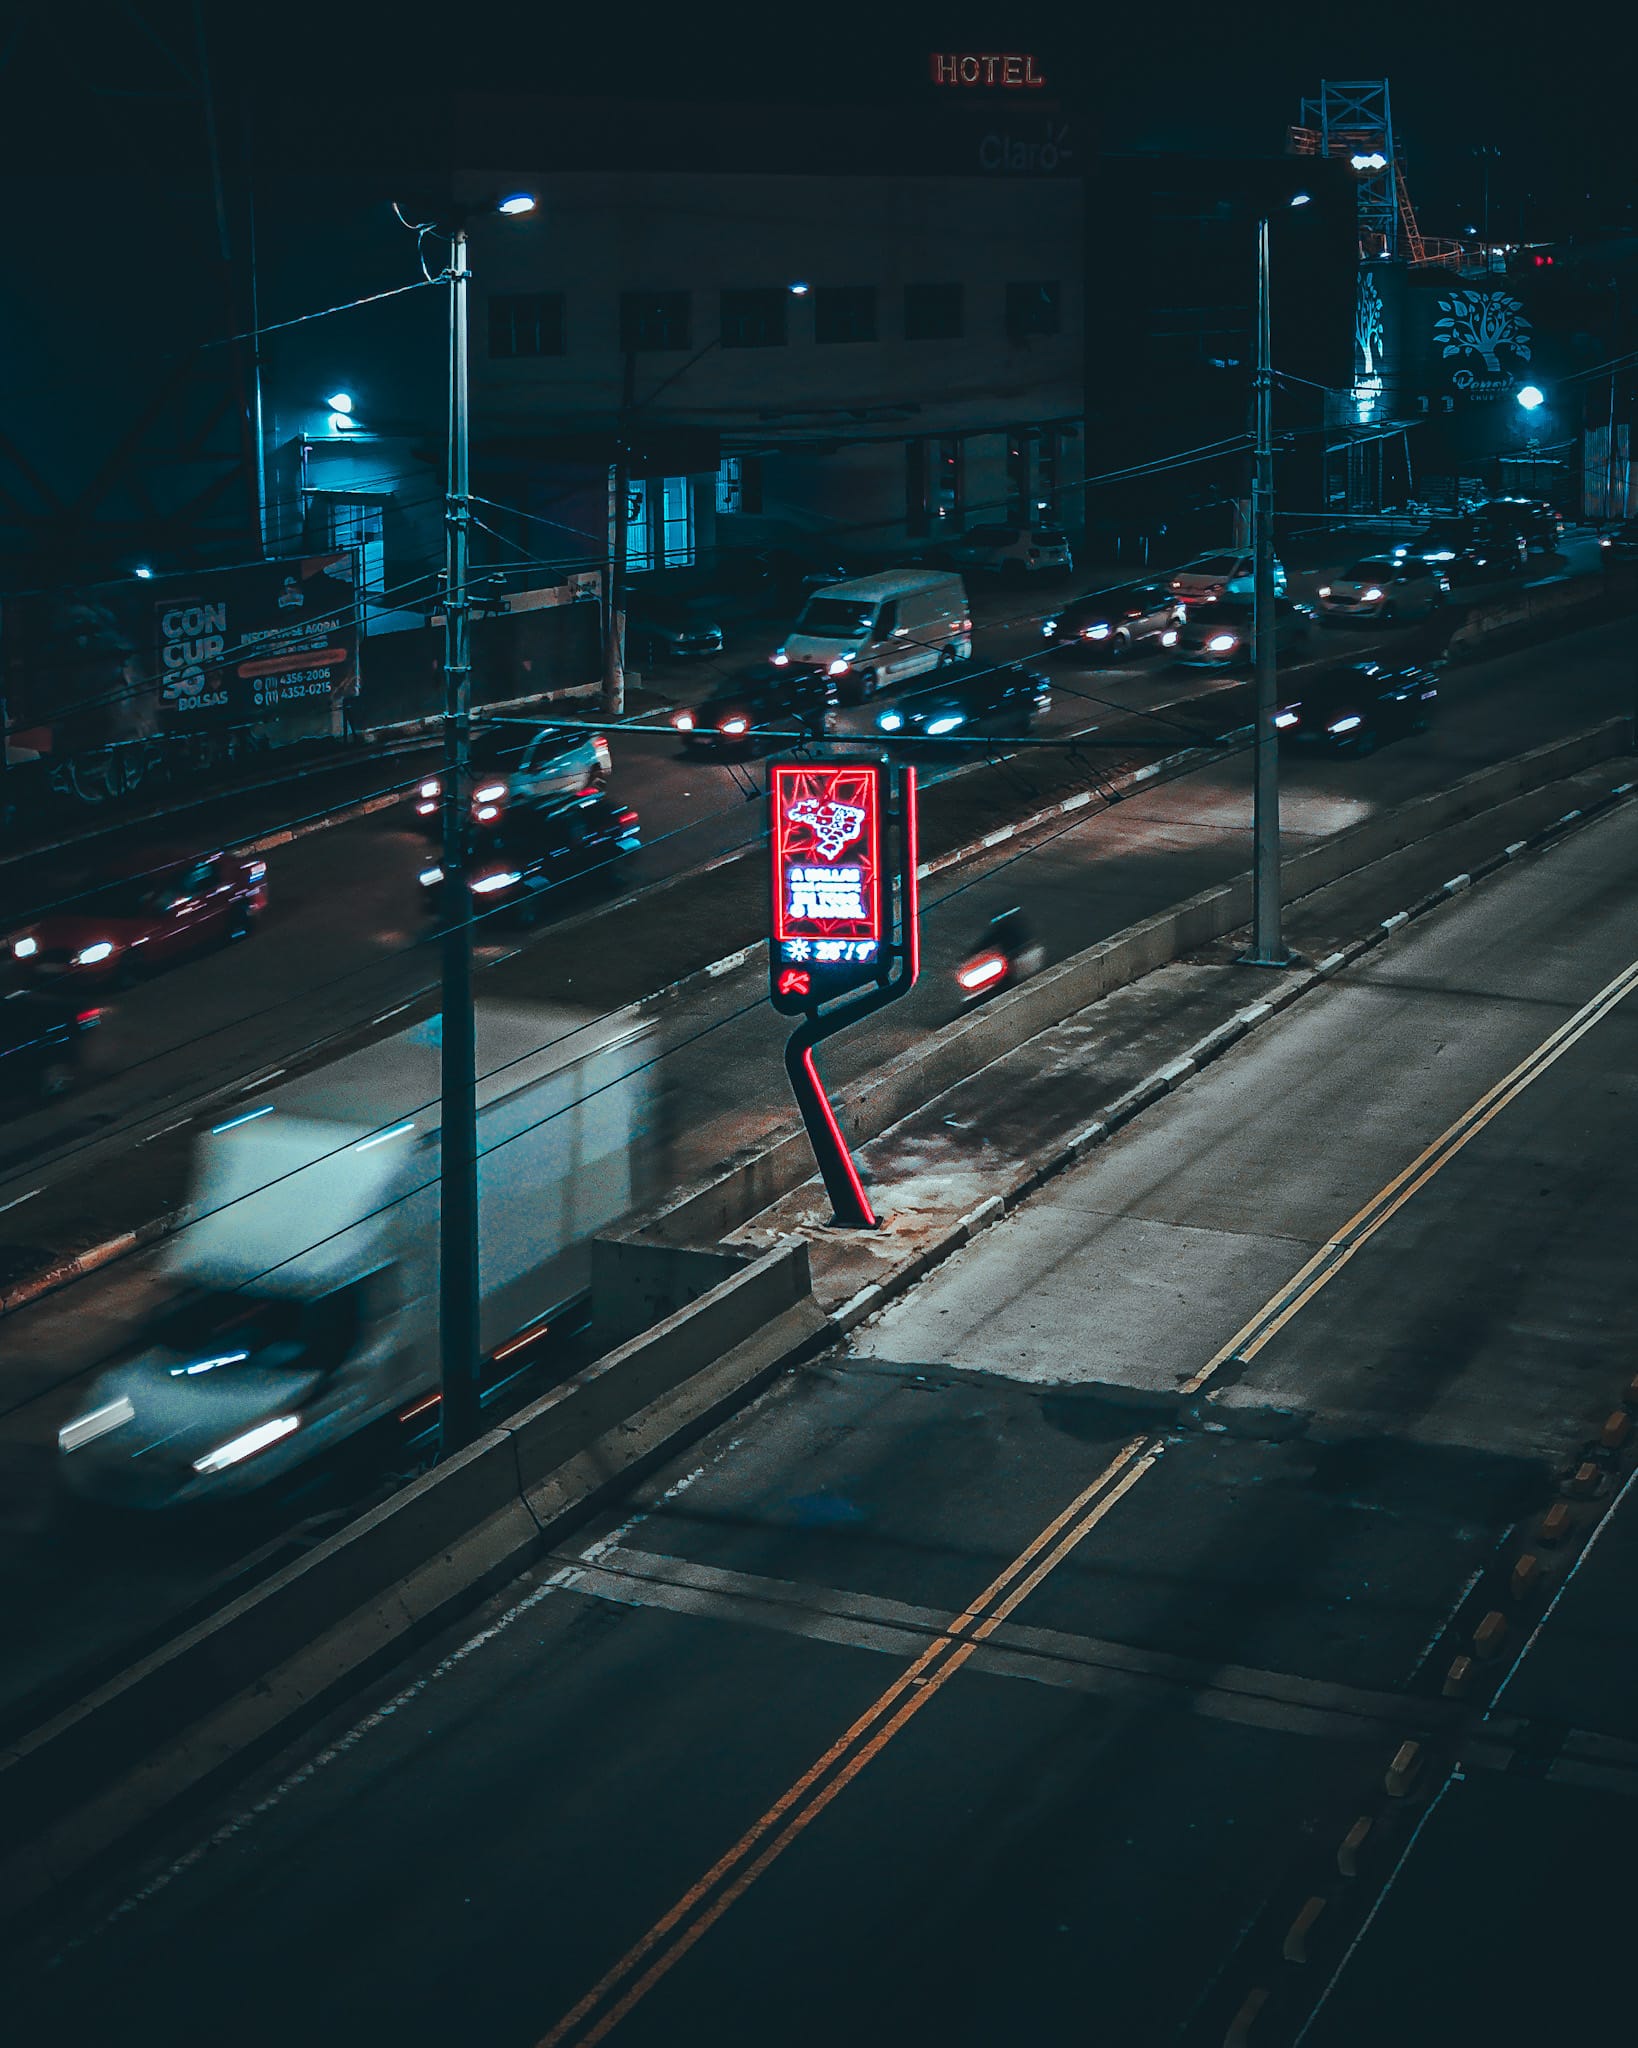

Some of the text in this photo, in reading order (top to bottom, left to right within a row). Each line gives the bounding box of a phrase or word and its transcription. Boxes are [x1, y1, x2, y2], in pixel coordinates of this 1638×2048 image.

[936, 54, 1043, 84] HOTEL
[978, 134, 1058, 169] Claro
[161, 602, 227, 638] CON
[161, 634, 226, 668] CUR
[280, 667, 331, 686] 4356-2006
[281, 681, 332, 700] 4352-0215
[178, 690, 229, 712] BOLSAS
